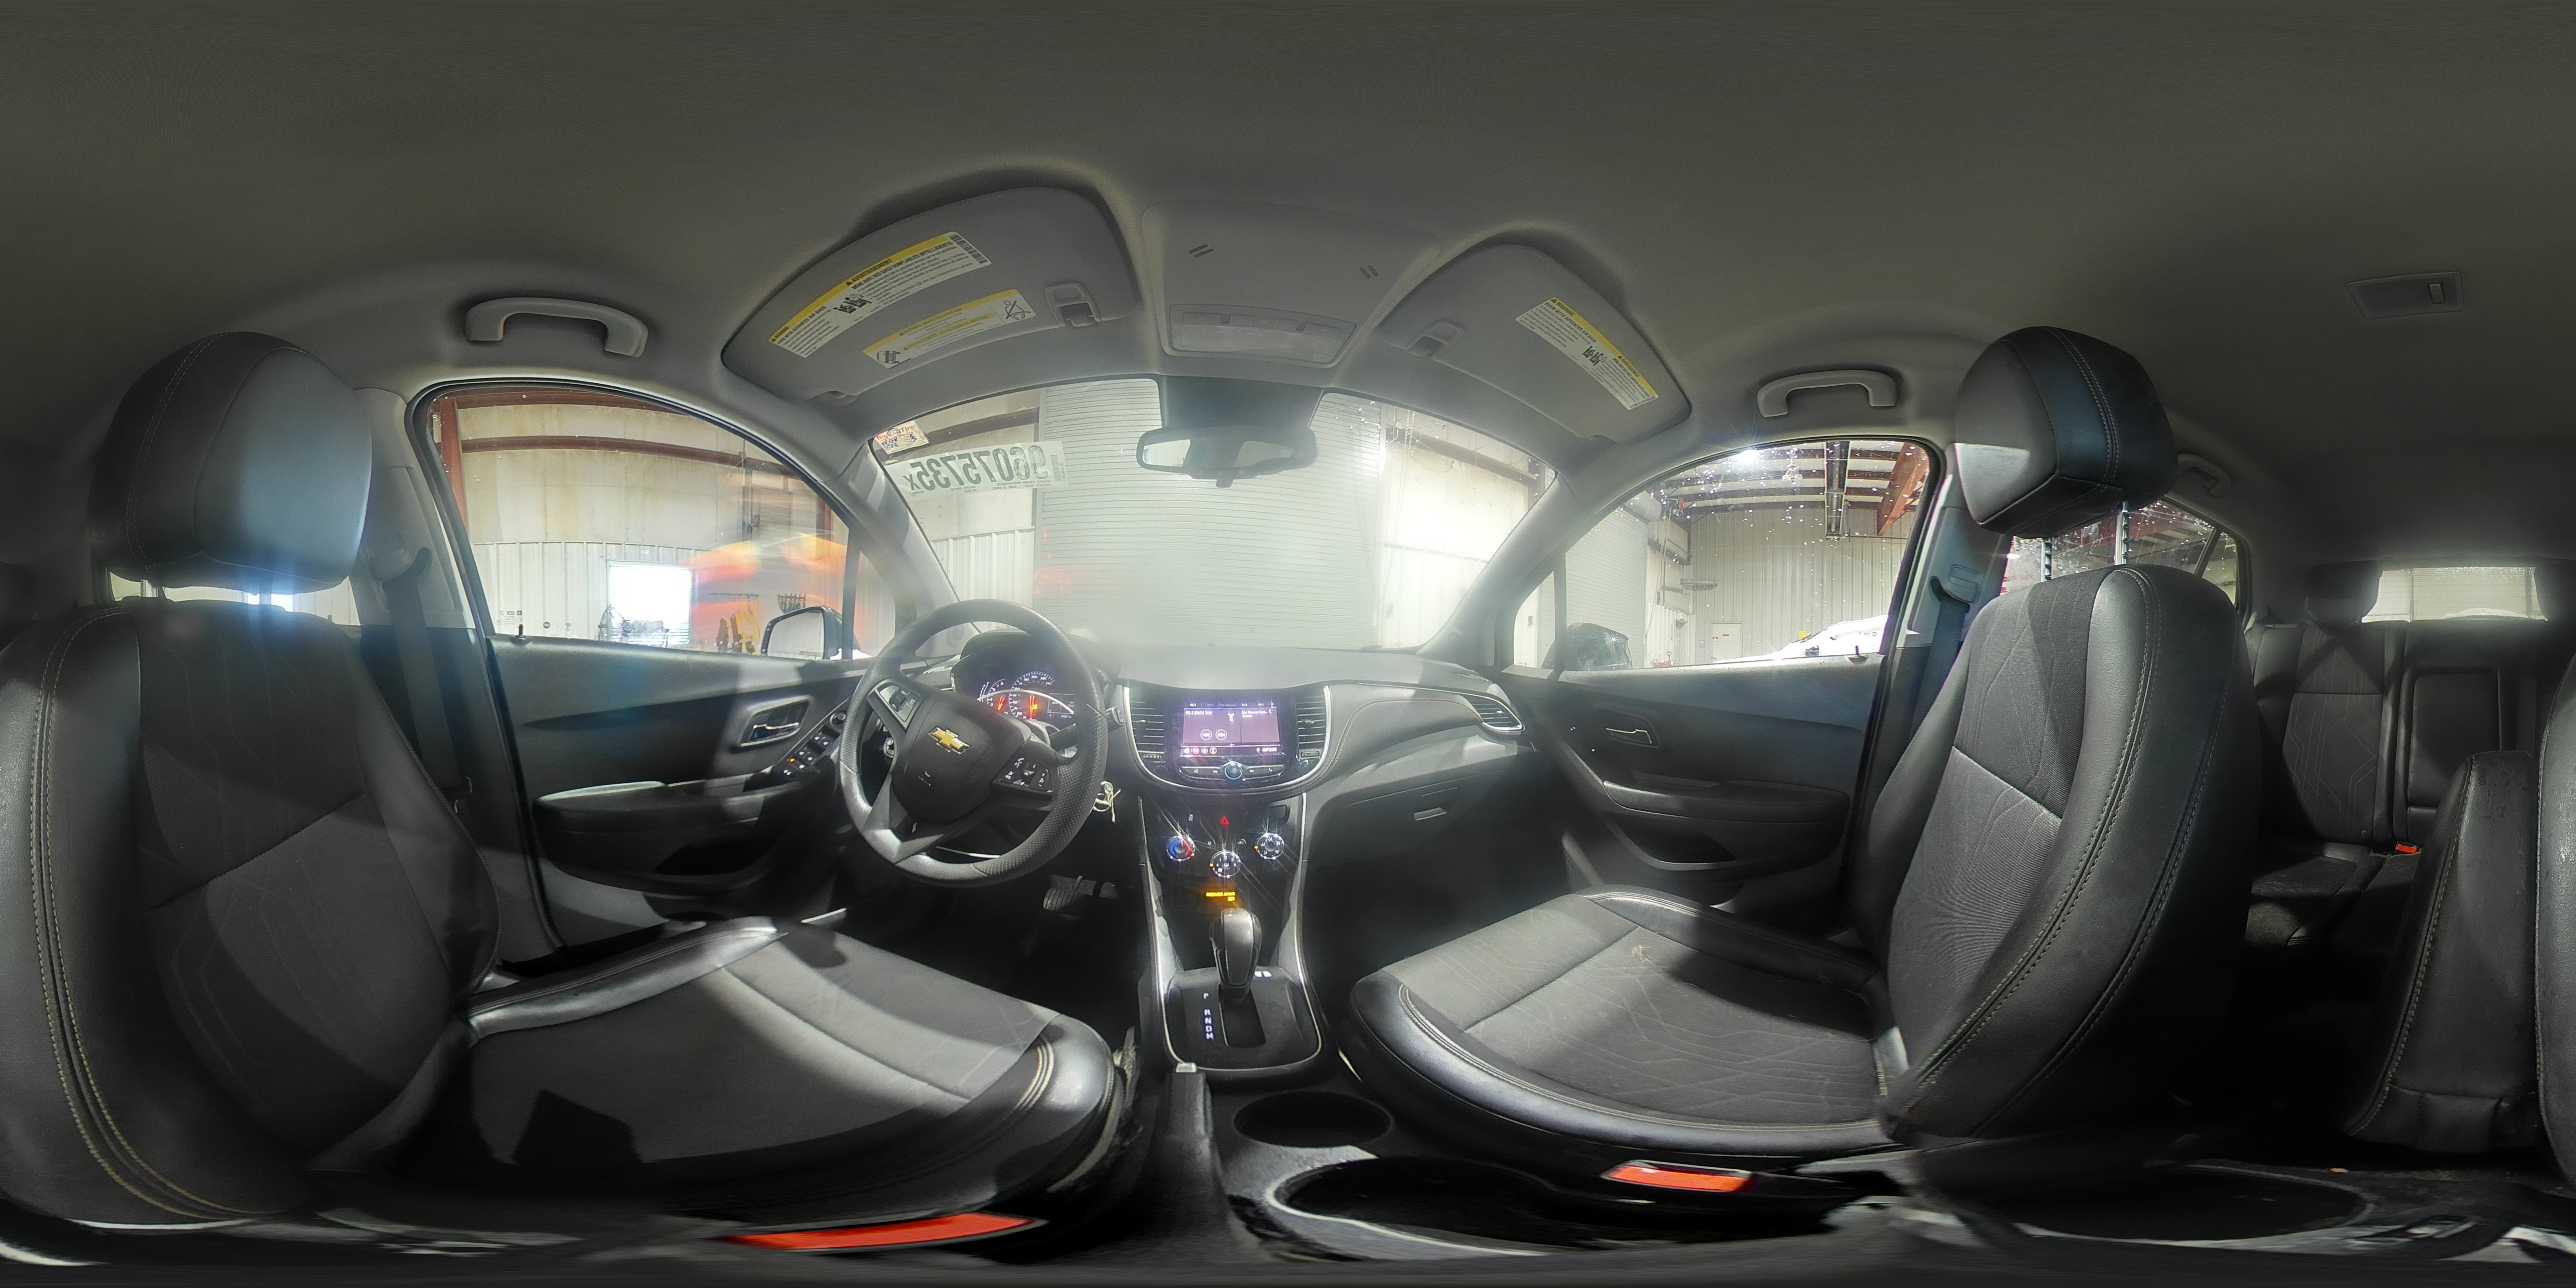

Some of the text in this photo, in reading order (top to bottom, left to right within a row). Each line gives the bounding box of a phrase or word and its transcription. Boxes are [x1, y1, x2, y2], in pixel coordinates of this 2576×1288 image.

[852, 258, 893, 283] AVERTISSEMENT
[1545, 302, 1555, 310] EVEN
[1555, 309, 1565, 317] WITH
[1565, 317, 1583, 331] ADVANCED
[1556, 302, 1575, 316] WARNING
